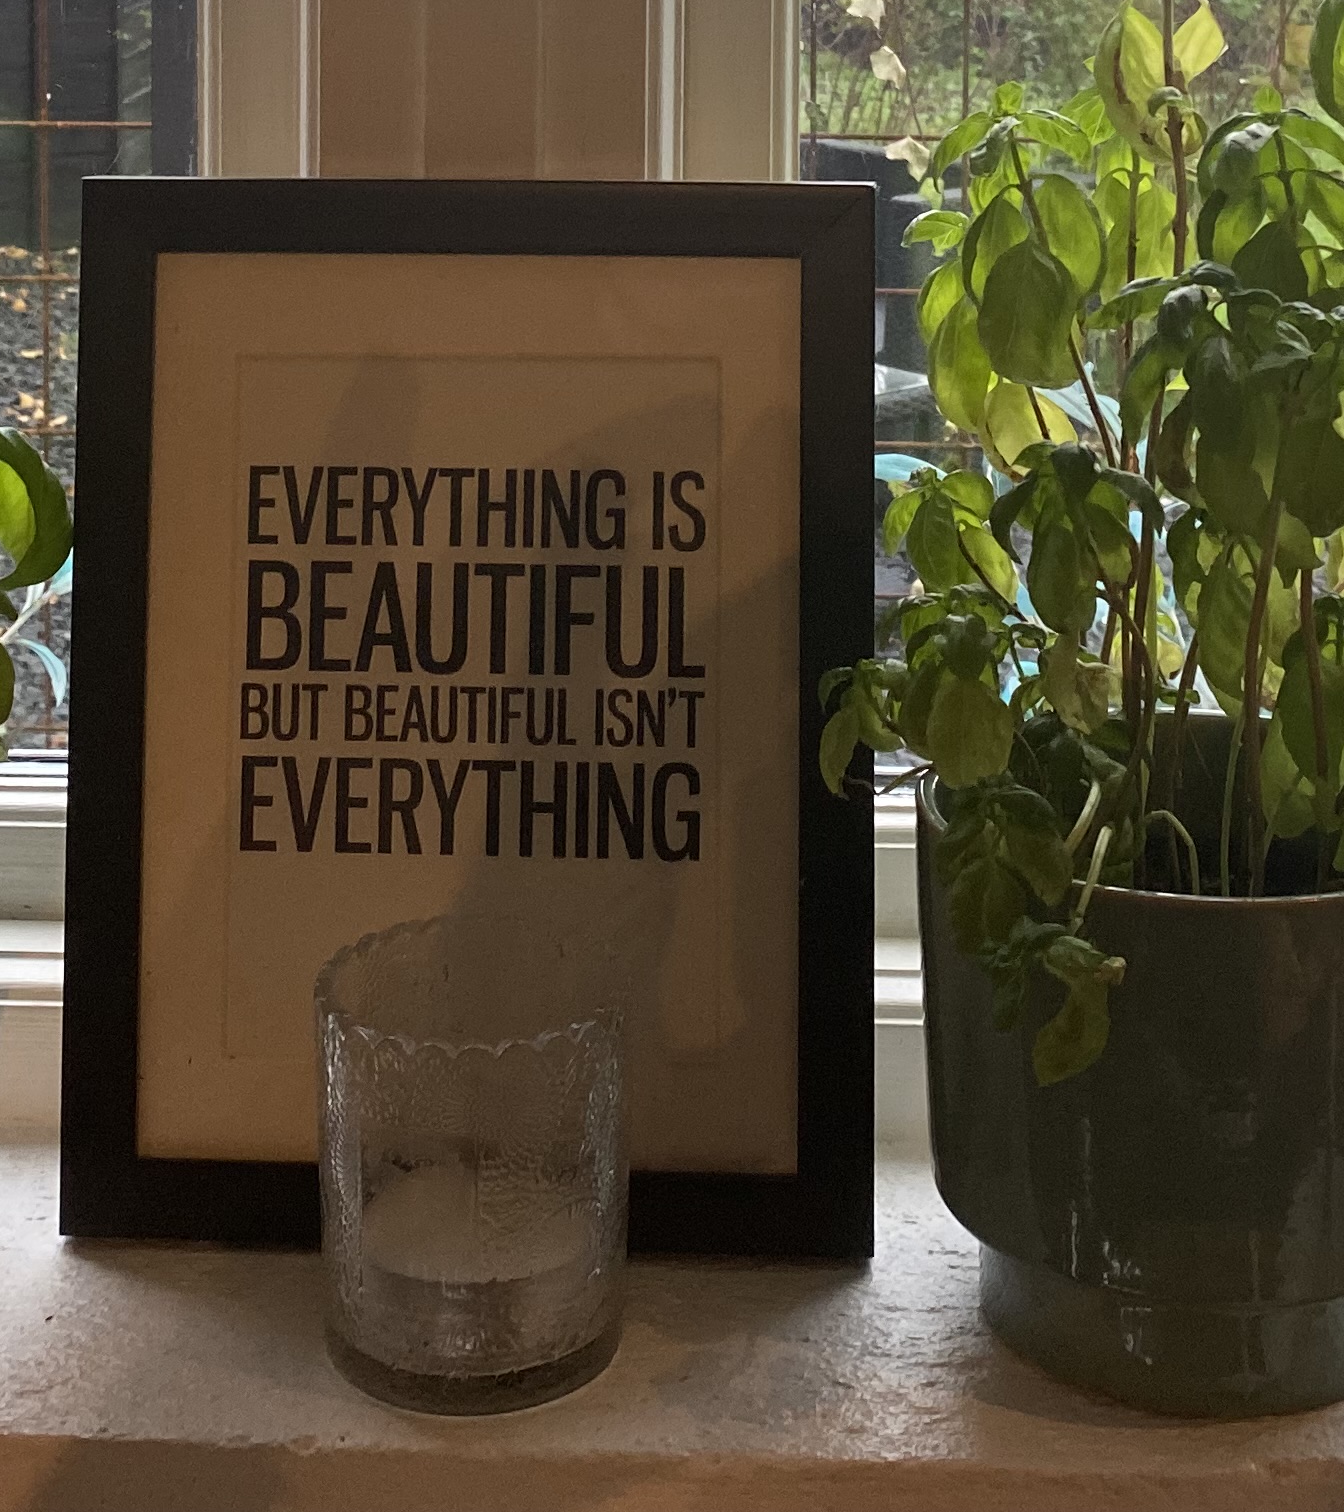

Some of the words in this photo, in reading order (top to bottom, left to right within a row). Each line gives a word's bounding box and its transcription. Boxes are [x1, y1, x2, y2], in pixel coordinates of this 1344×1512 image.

[247, 465, 627, 550] EVERYTHING
[651, 470, 707, 552] IS
[245, 559, 706, 678] BEAUTIFUL
[239, 683, 328, 741] BUT
[343, 684, 577, 746] BEAUTIFUL
[594, 688, 706, 748] ISN'T
[239, 756, 702, 862] EVERYTHING
